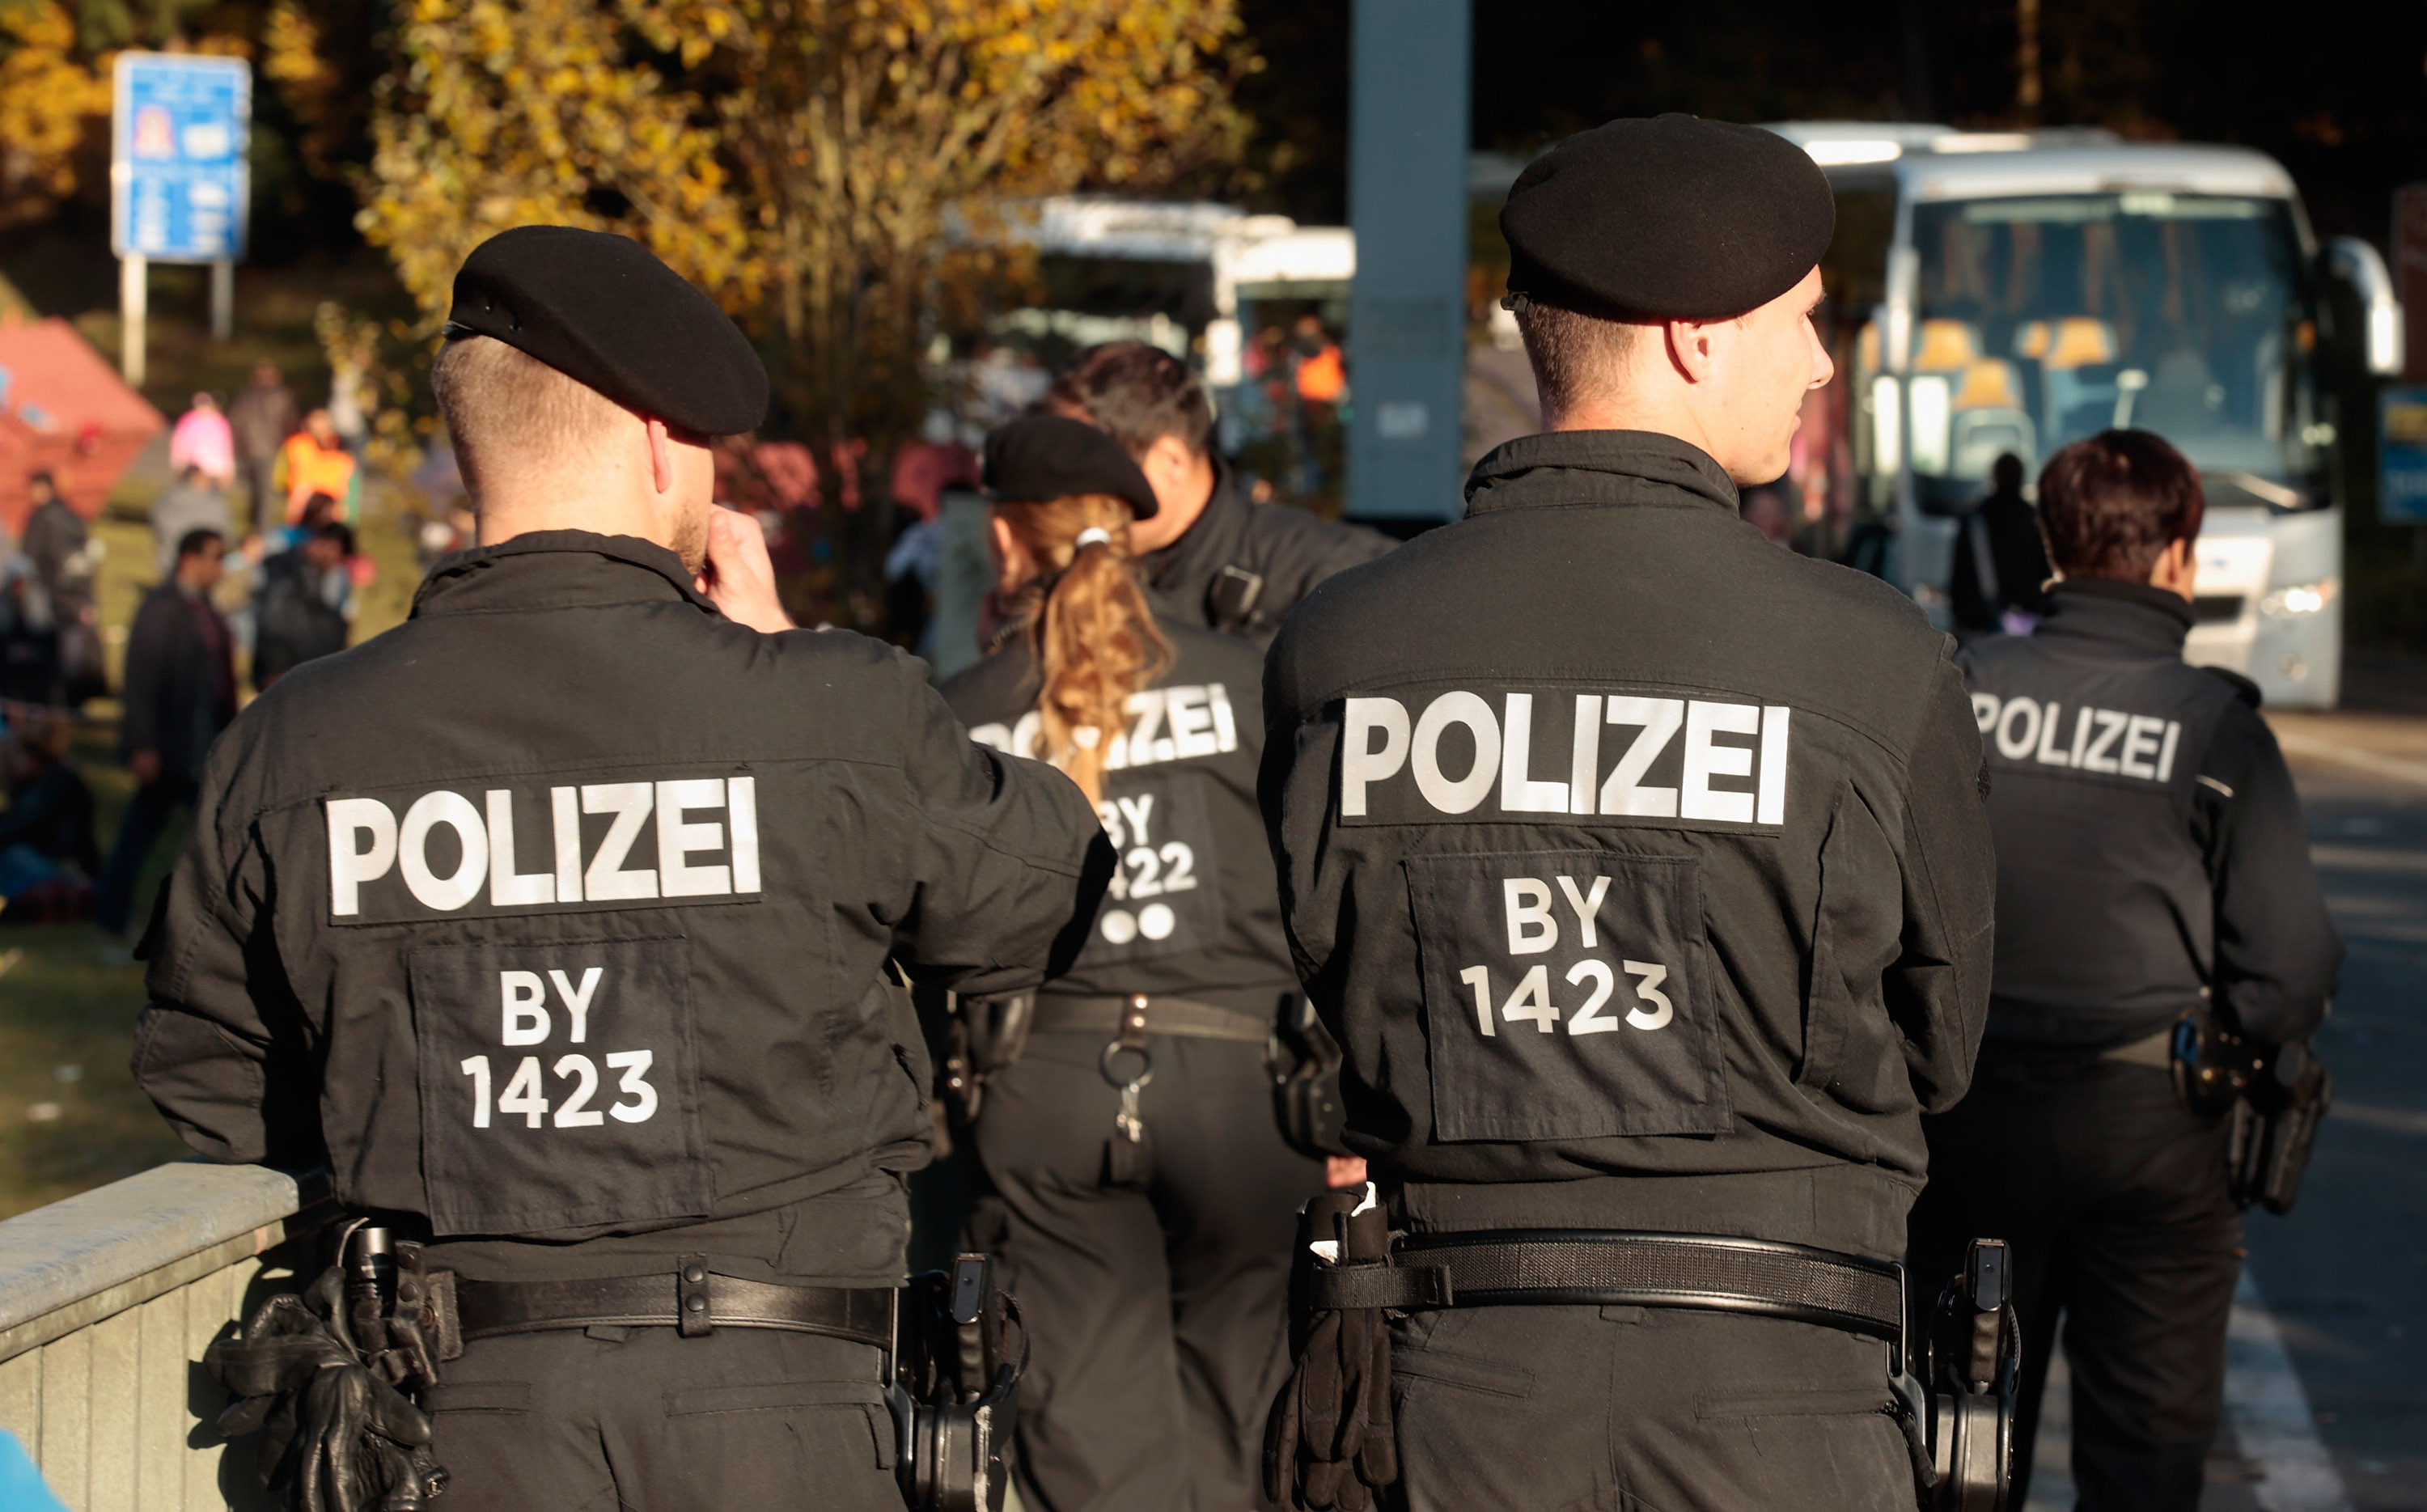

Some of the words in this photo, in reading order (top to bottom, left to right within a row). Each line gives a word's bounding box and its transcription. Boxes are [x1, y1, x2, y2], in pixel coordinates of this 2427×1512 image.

[969, 684, 1238, 769] OZEI
[1342, 691, 1790, 825] POLIZEI
[1972, 692, 2181, 782] POLIZEI
[326, 777, 761, 916] POLIZEI
[1109, 841, 1197, 900] 422
[1503, 875, 1612, 955] BY
[500, 968, 604, 1046] BY
[1460, 959, 1673, 1036] 1423
[461, 1049, 658, 1128] 1423
